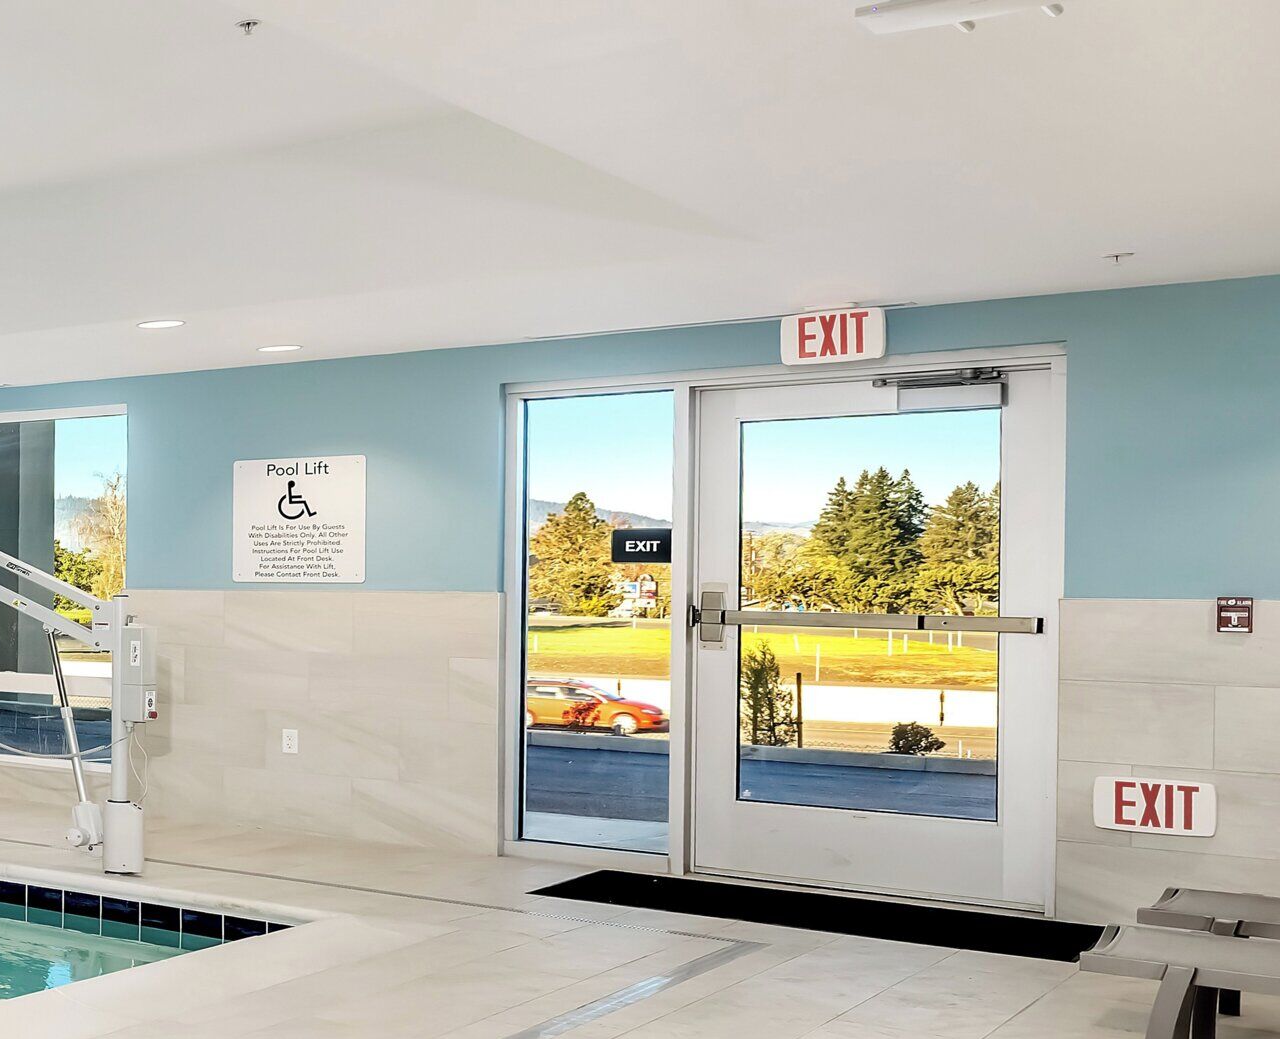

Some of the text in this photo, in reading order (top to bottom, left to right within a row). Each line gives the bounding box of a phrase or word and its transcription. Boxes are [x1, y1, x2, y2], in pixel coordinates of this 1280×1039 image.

[798, 312, 868, 358] EXIT
[267, 461, 329, 476] Pool Lift
[626, 540, 660, 552] EXIT
[1114, 780, 1200, 830] EXIT
